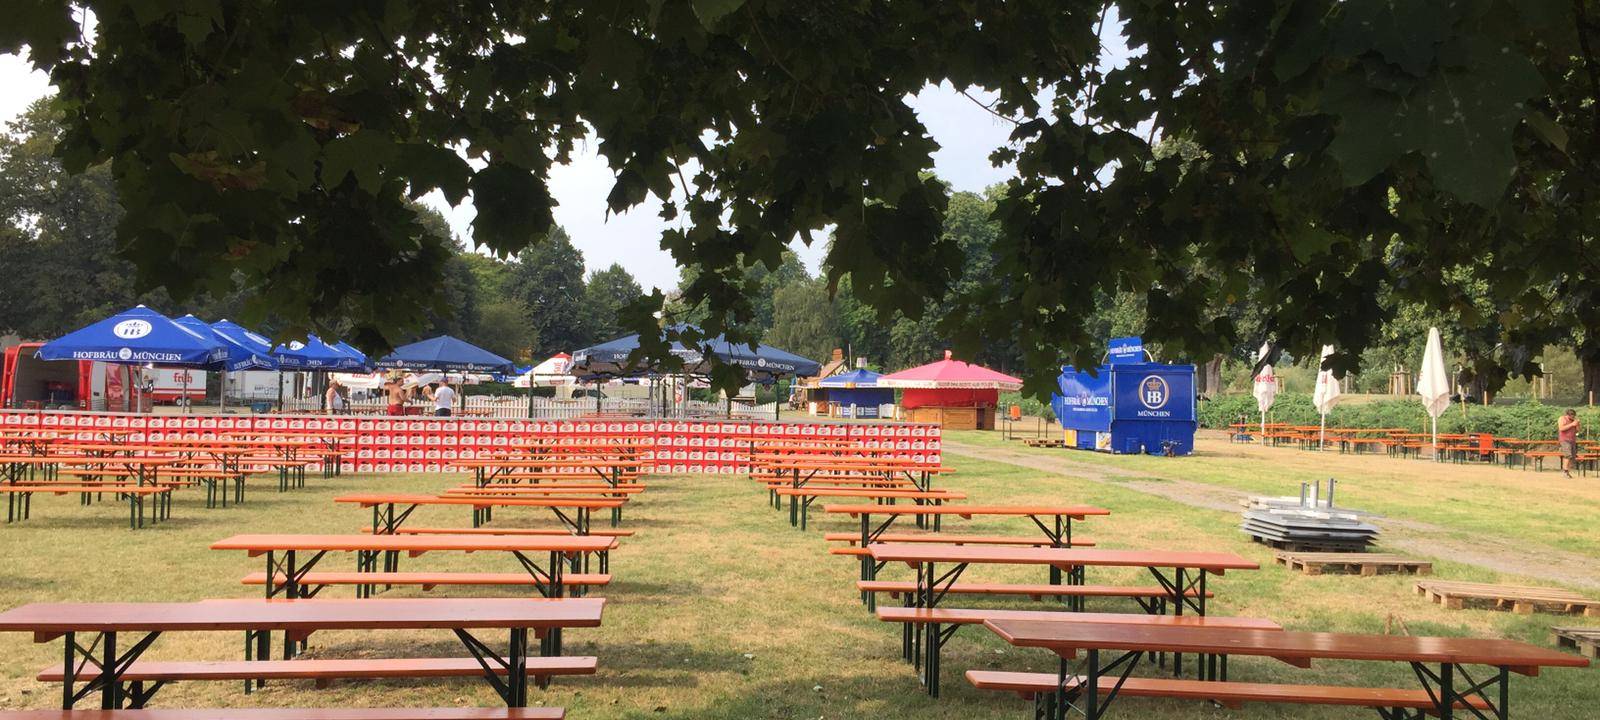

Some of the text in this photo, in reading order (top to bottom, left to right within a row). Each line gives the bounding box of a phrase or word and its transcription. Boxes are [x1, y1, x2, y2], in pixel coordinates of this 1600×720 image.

[73, 350, 182, 361] HOFBRÄU MÜNCHEN
[765, 361, 795, 371] MÜNCHEN
[1146, 391, 1162, 404] HB
